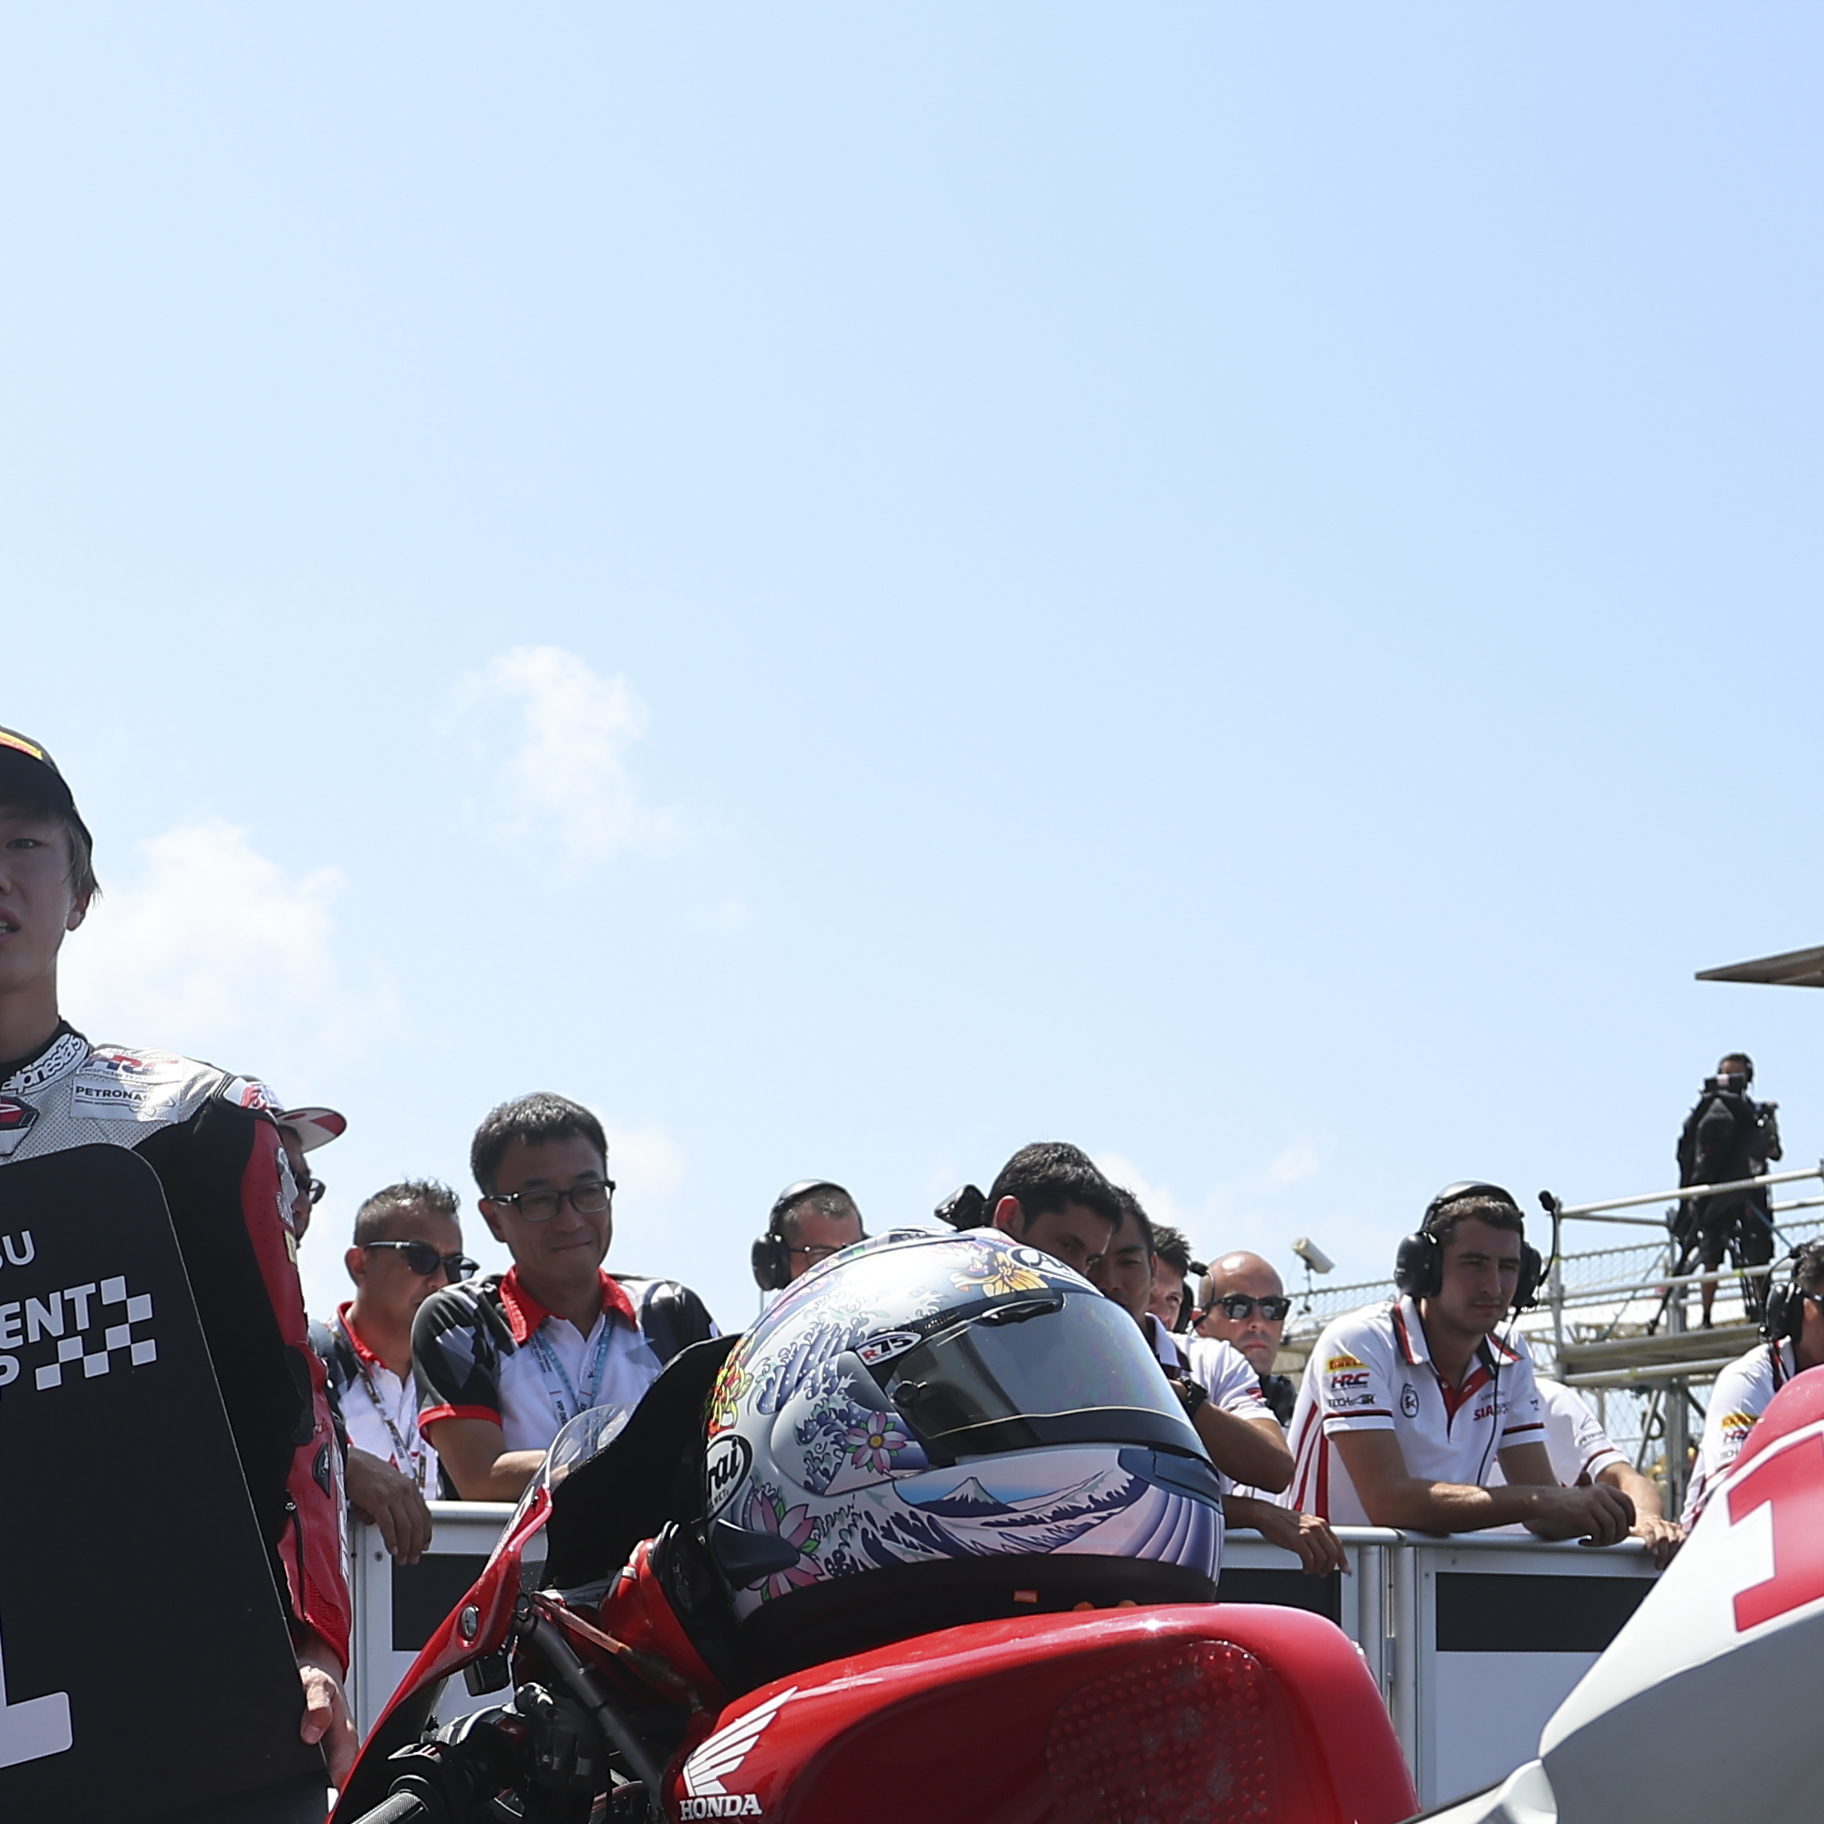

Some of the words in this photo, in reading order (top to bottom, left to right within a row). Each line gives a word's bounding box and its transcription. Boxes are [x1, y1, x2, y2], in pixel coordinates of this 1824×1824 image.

[862, 1335, 913, 1361] R75
[1330, 1372, 1371, 1389] HRC
[679, 1793, 763, 1822] HONDA
